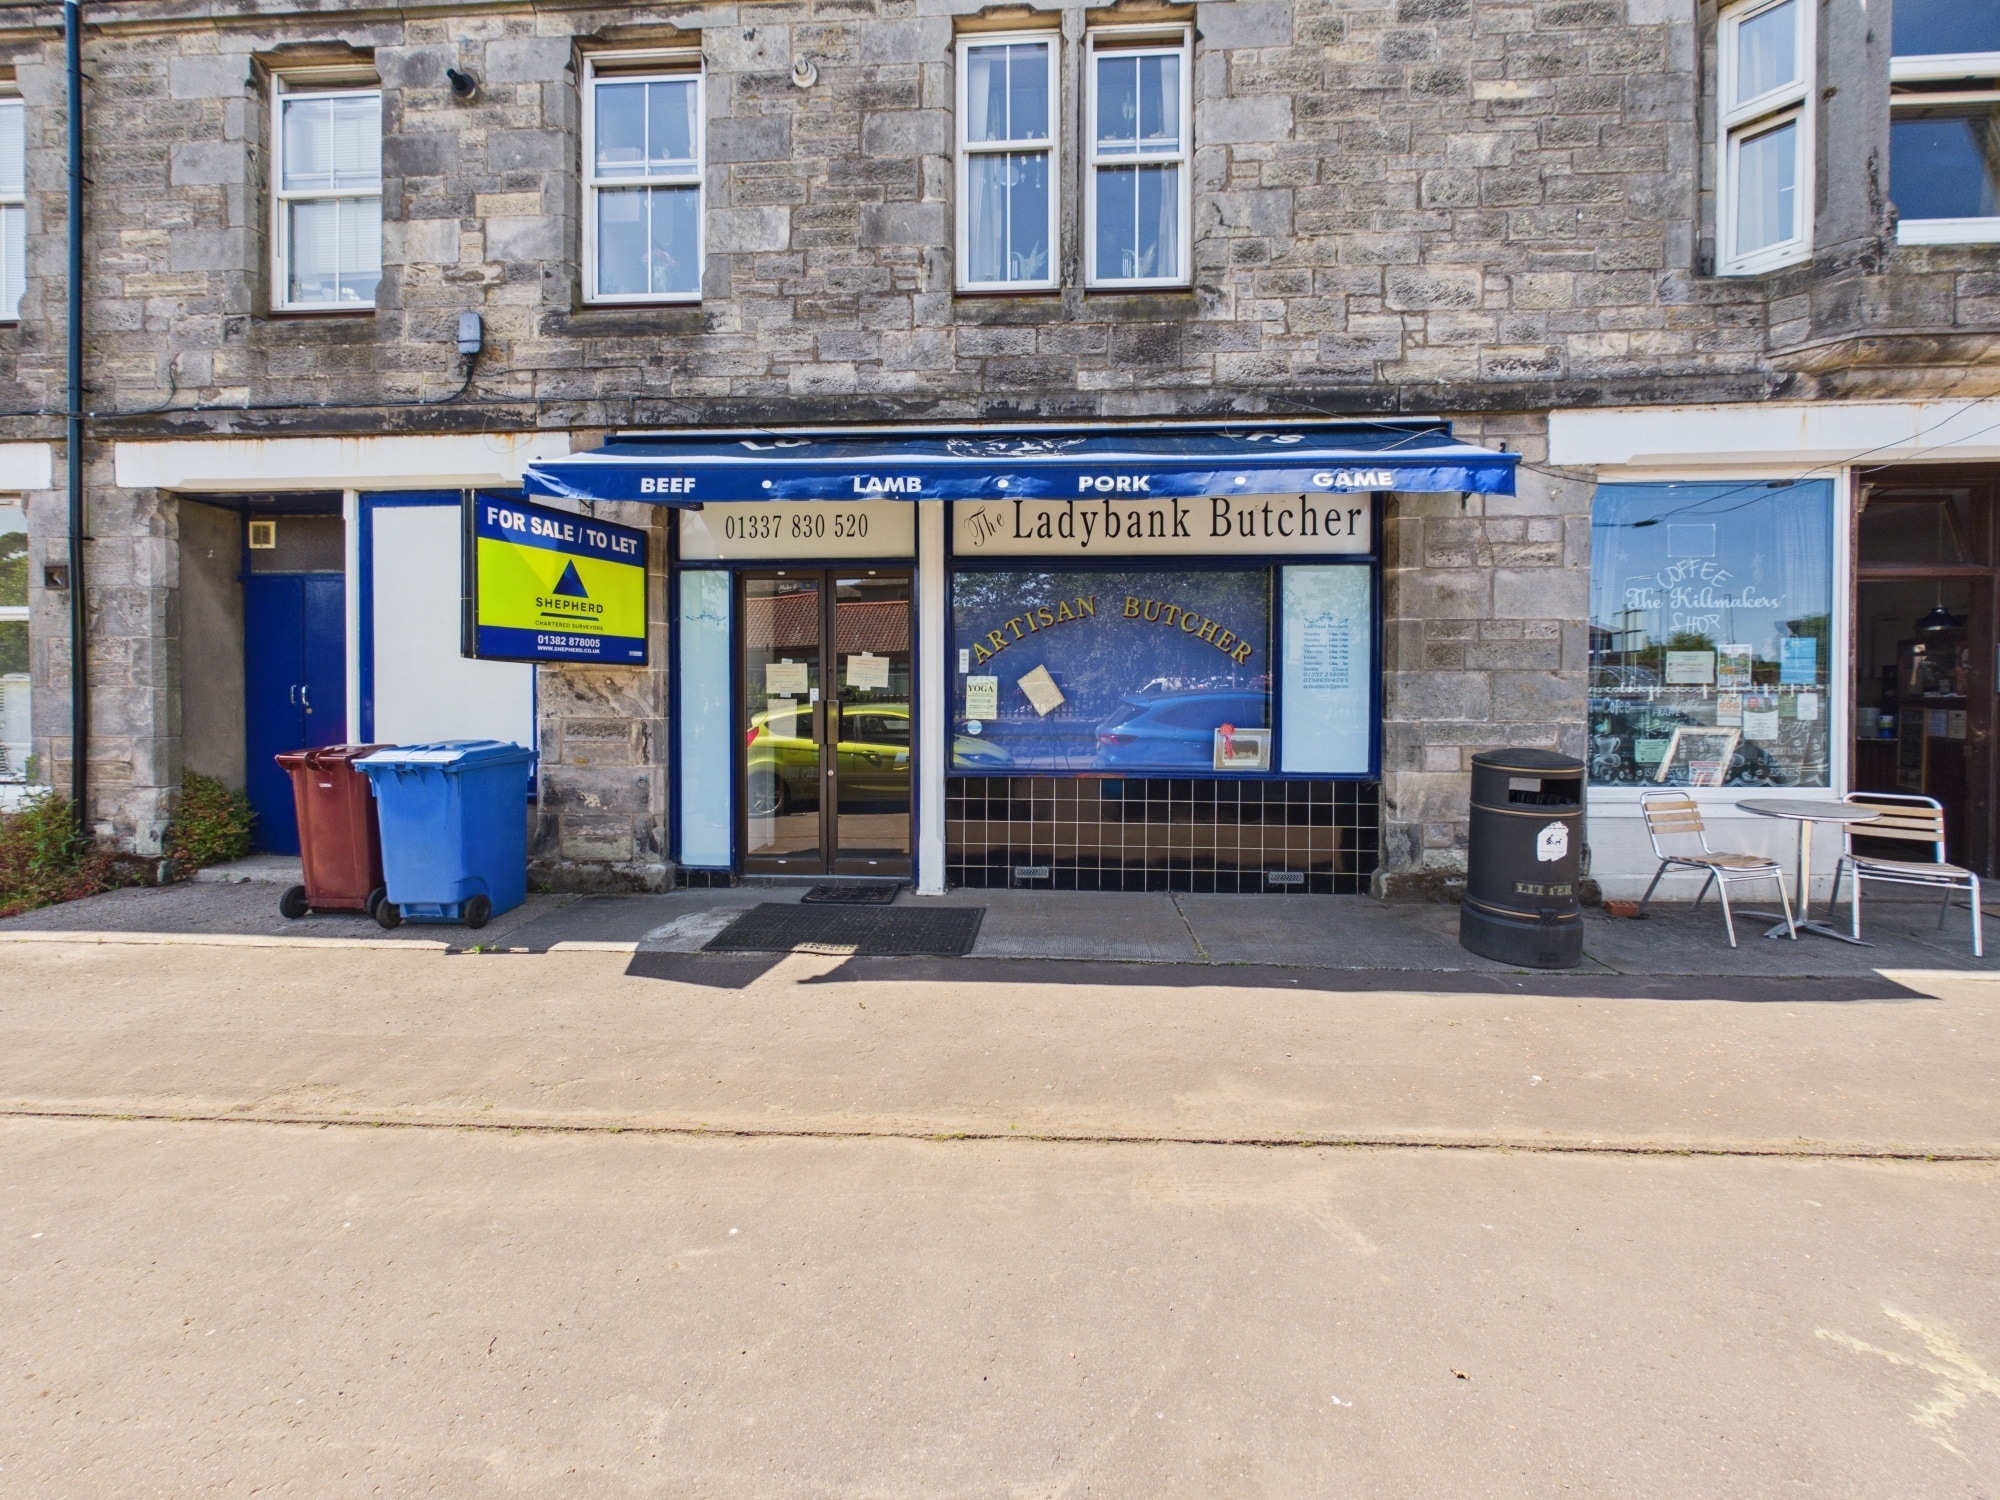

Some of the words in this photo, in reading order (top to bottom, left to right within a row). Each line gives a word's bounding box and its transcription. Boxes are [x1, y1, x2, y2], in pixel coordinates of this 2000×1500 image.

[640, 477, 696, 493] BEEF
[853, 476, 922, 493] LAMB
[1078, 475, 1150, 492] PORK
[1312, 471, 1393, 487] GAME
[487, 506, 526, 532] FOR
[530, 516, 574, 542] SALE
[578, 527, 583, 543] /
[586, 529, 607, 548] TO
[611, 535, 638, 554] LET
[725, 515, 782, 539] 01337
[792, 514, 825, 538] 830
[834, 513, 868, 538] 520
[963, 505, 1005, 548] The
[1012, 498, 1191, 548] Ladybank
[1209, 495, 1363, 538] Butcher
[1656, 558, 1734, 590] COFFEE
[535, 597, 604, 614] SHEPHERD
[1625, 587, 1664, 609] The
[535, 620, 571, 628] CHARTERED
[572, 623, 604, 631] SURVEYORS
[970, 595, 1096, 666] ARTISAN
[1122, 596, 1253, 667] BUTCHER
[1669, 611, 1721, 635] SHOP
[537, 635, 566, 646] 01382
[568, 637, 601, 648] 878005
[537, 645, 601, 654] WWW.SHEPHERD.CO.UK
[968, 684, 994, 693] YOGA
